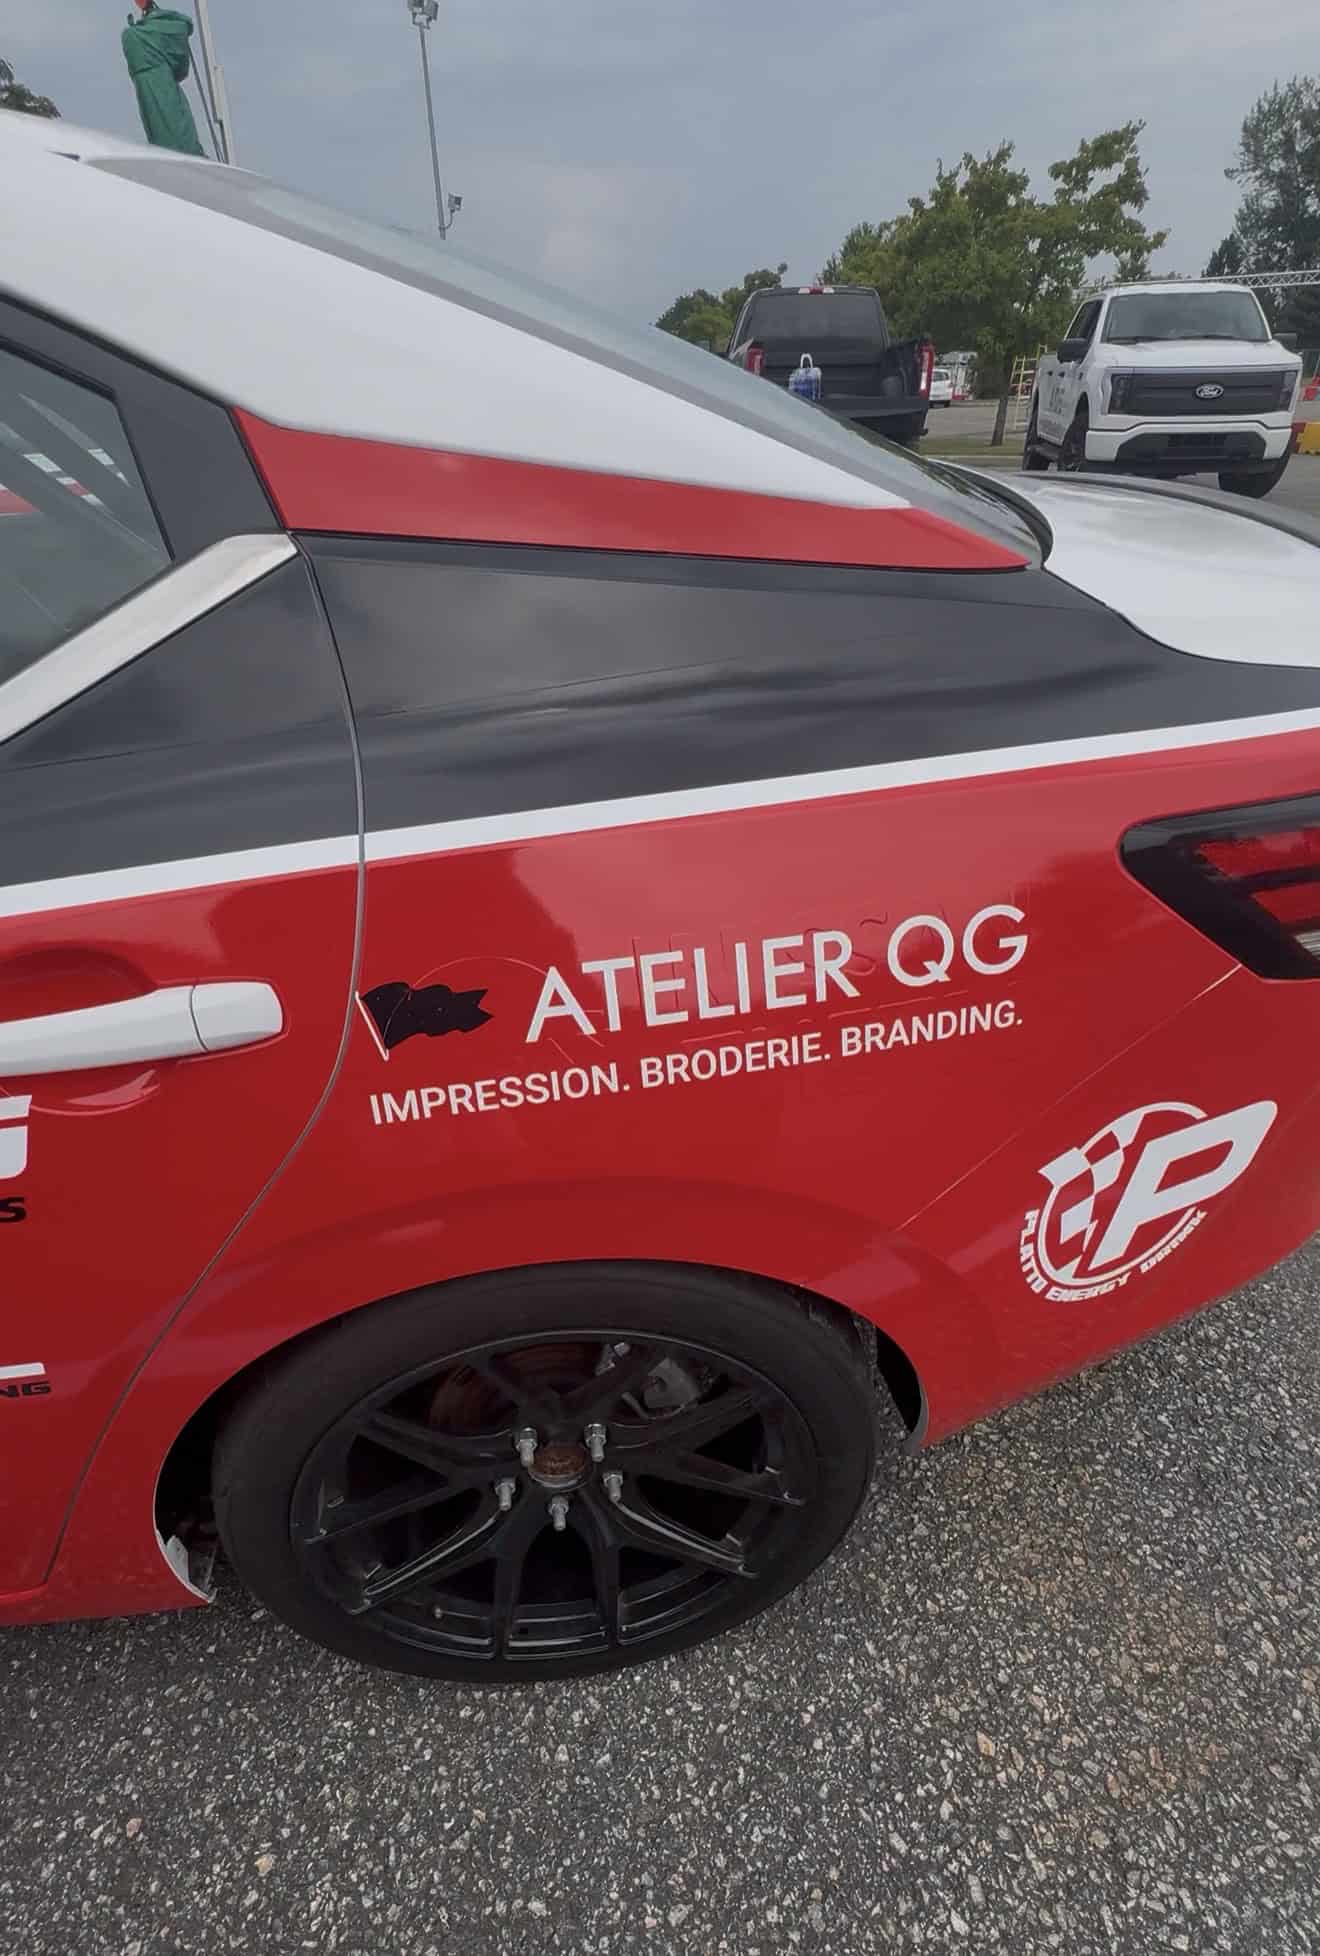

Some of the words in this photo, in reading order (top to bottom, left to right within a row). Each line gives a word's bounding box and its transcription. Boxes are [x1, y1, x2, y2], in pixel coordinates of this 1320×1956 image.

[526, 929, 860, 1042] ATELIER
[887, 904, 1028, 987] QG
[370, 1062, 630, 1125] IMPRESSION.
[640, 1030, 831, 1089] BRODERIE.
[840, 1000, 1024, 1057] BRANDING.
